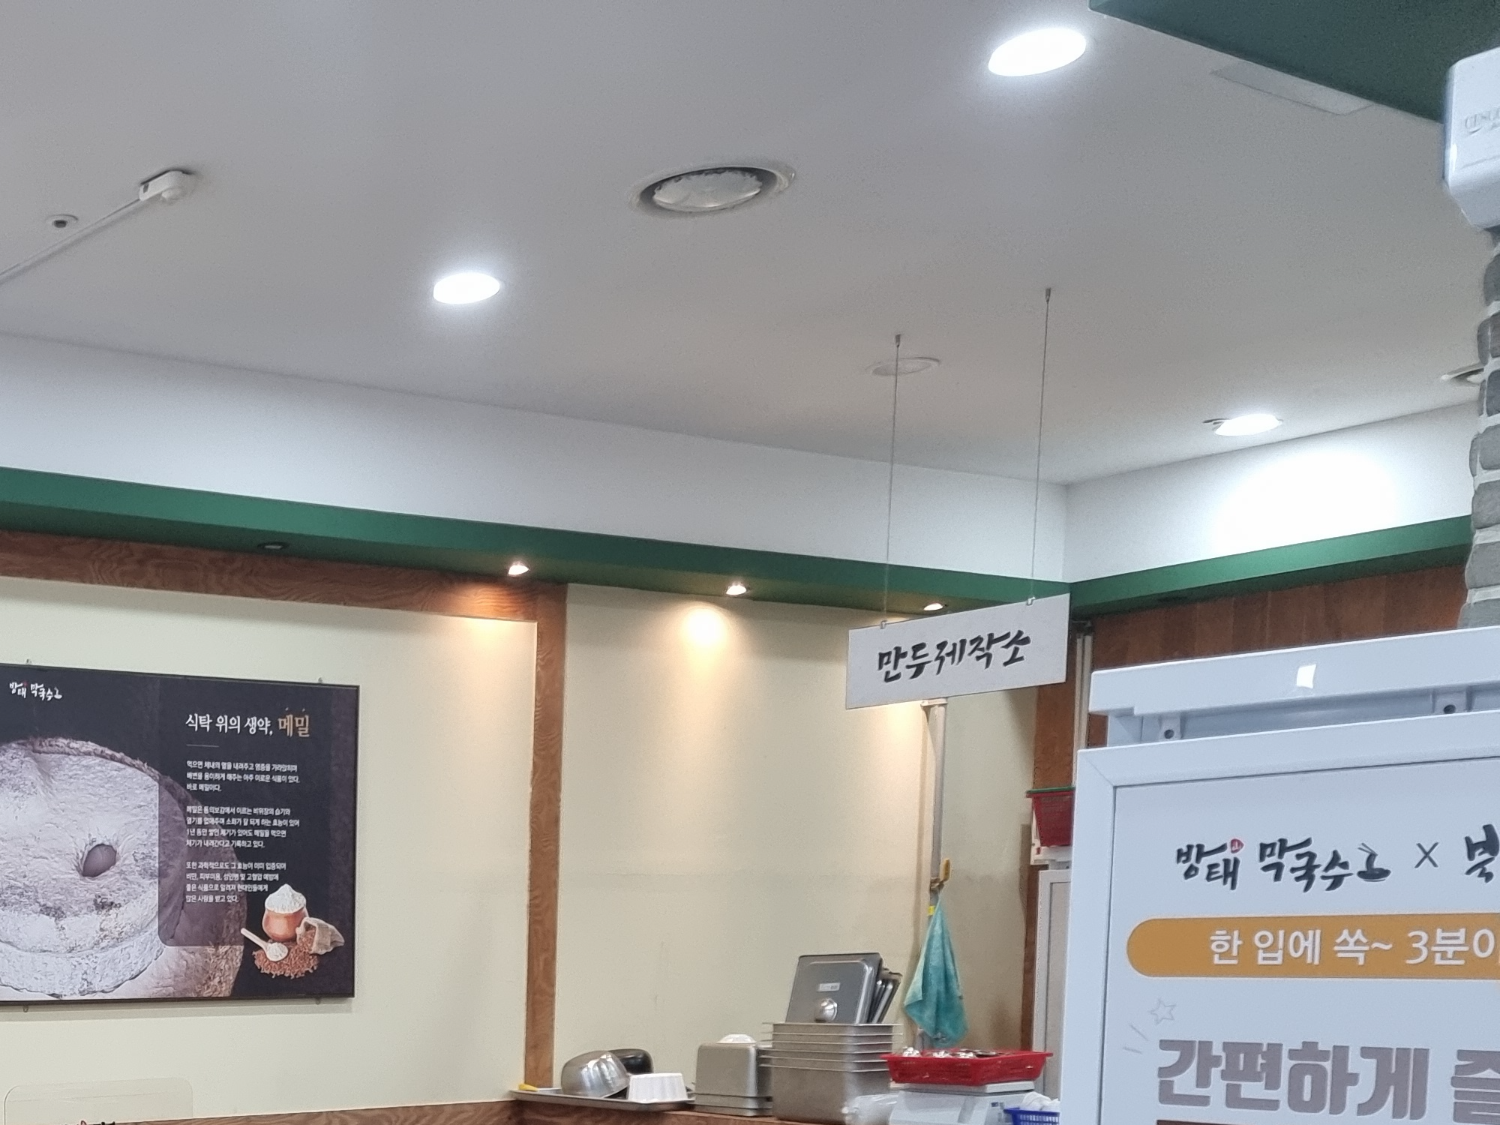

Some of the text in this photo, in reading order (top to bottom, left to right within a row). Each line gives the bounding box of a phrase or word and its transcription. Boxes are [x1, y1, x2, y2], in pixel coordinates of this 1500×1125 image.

[877, 629, 1032, 684] 만두제작소
[185, 713, 310, 737] 식탁 위의 생약, 메밀
[1176, 842, 1241, 890] 방태
[1259, 837, 1353, 893] 막국수
[1210, 929, 1243, 965] 한
[1253, 929, 1321, 965] 입에
[1157, 1038, 1430, 1121] 간편하게
